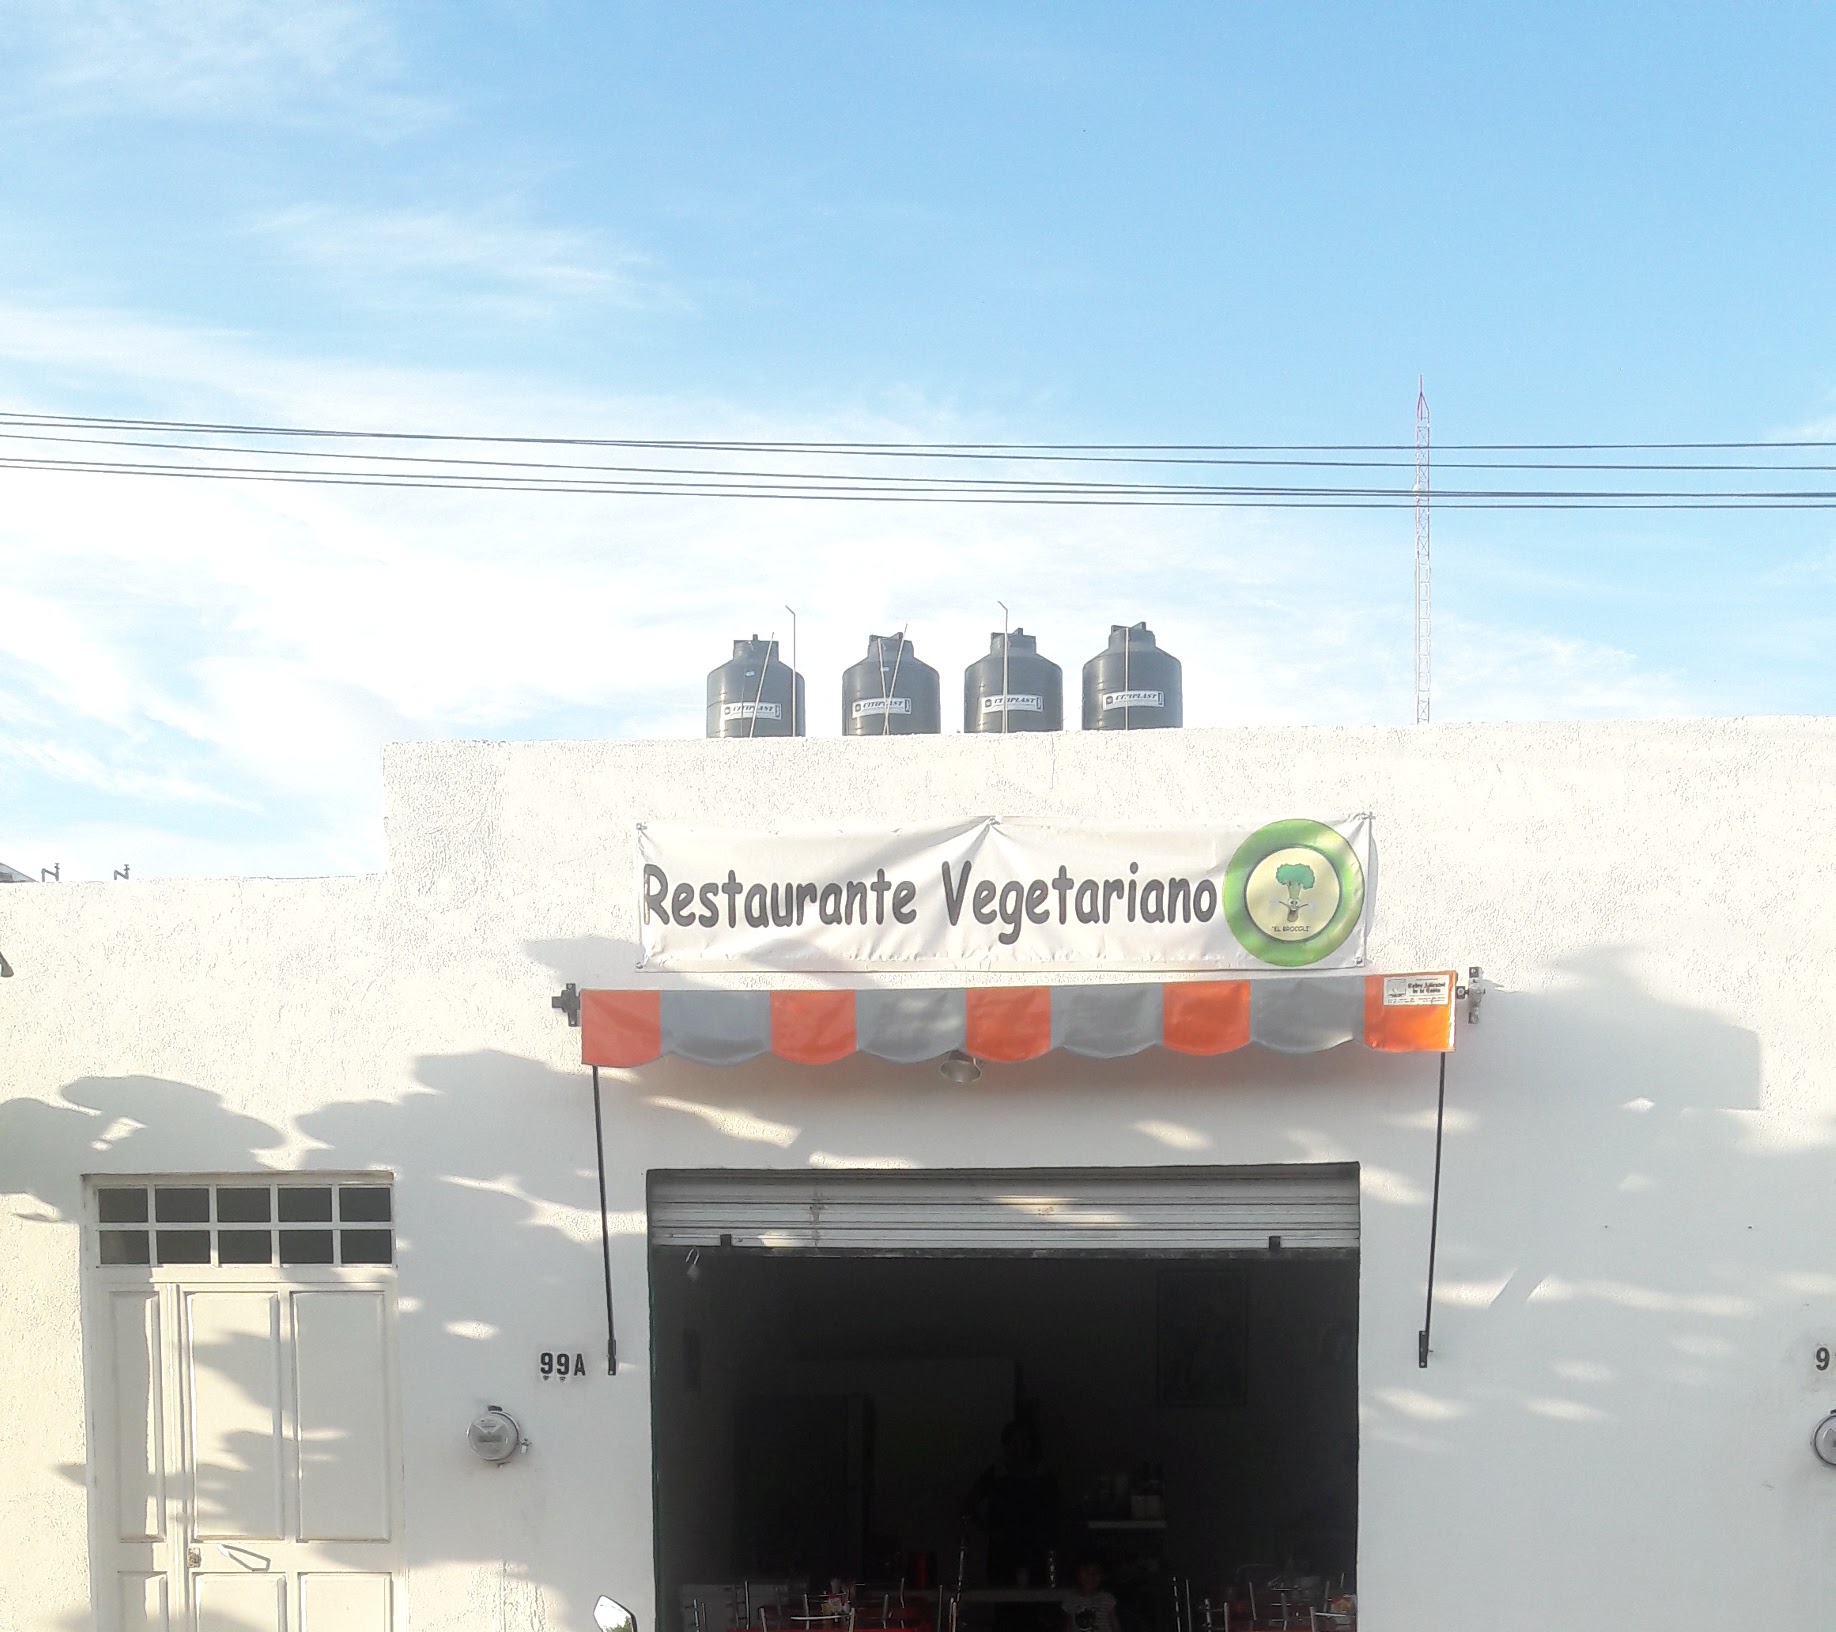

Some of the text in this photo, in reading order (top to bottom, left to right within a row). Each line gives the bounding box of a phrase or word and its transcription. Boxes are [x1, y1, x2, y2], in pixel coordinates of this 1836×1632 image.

[863, 700, 903, 708] CITIPAST
[643, 860, 1217, 945] Restaurante Vegetariano
[540, 1352, 586, 1376] 99A
[1815, 1347, 1836, 1371] 9
